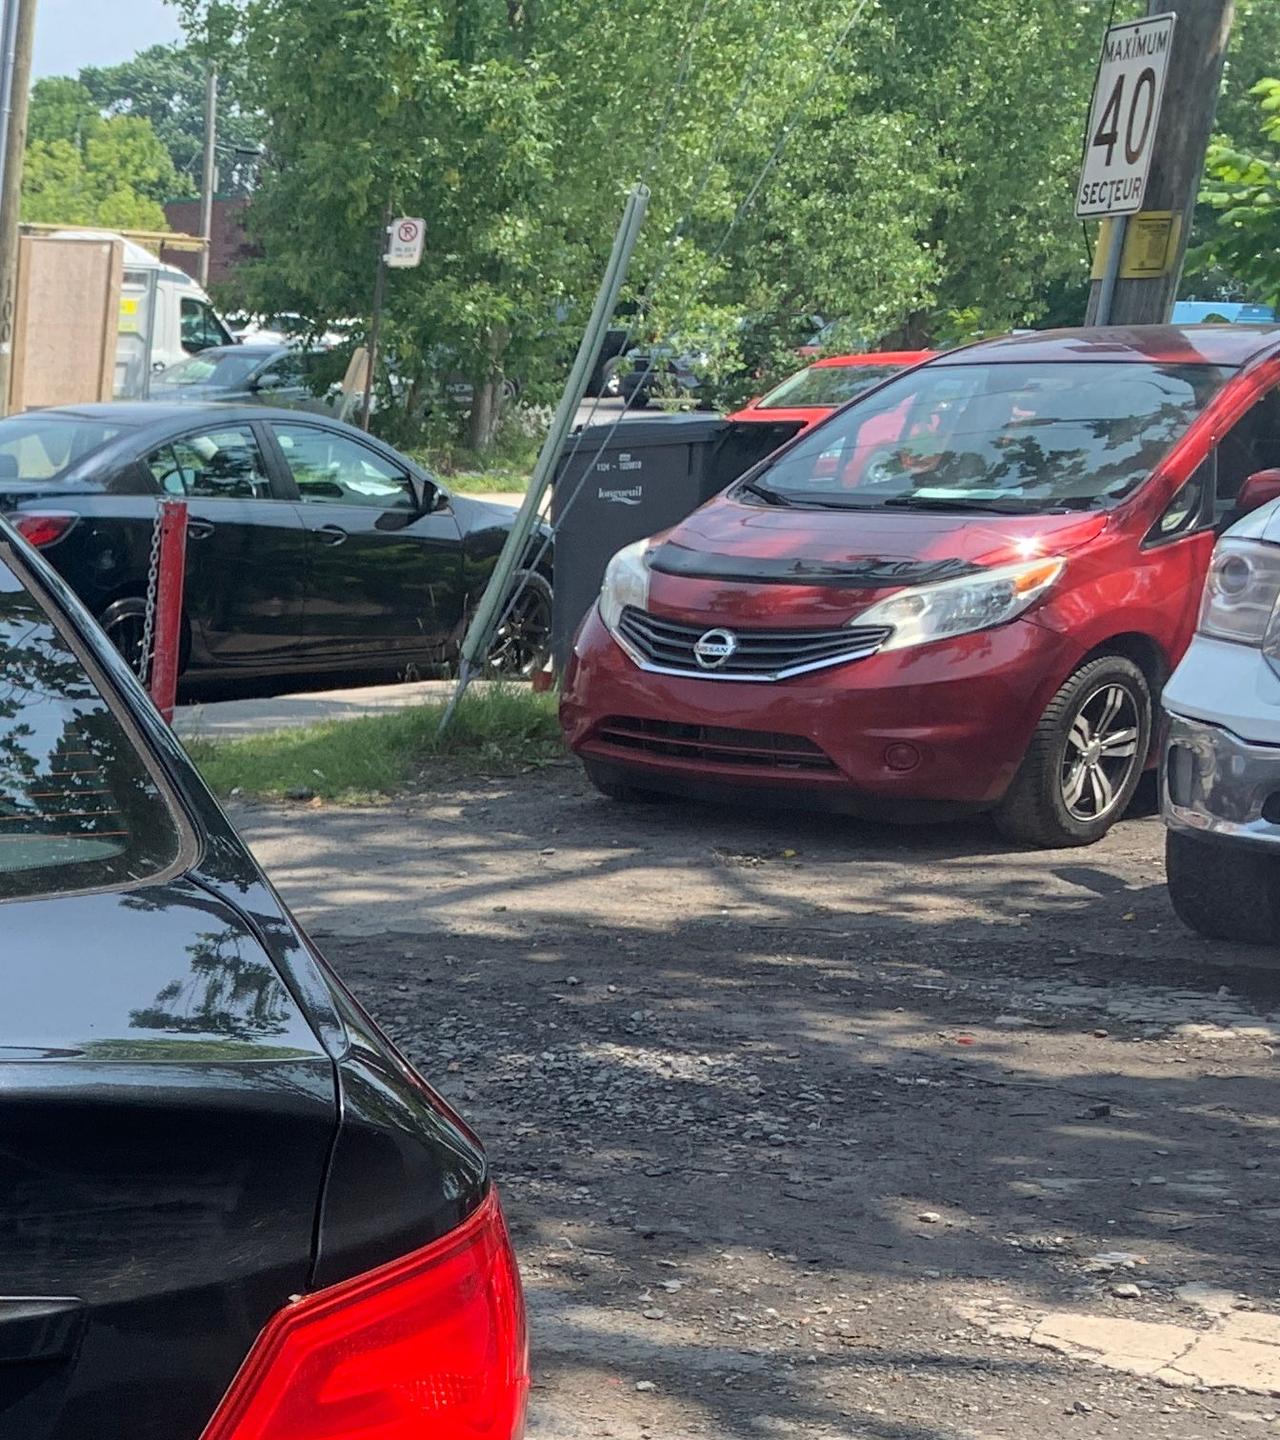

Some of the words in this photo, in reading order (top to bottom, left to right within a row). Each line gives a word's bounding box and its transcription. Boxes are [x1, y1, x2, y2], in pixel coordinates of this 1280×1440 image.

[1104, 30, 1168, 64] MAXIMUM
[1092, 66, 1156, 167] 40
[1080, 176, 1142, 206] SECTEUR
